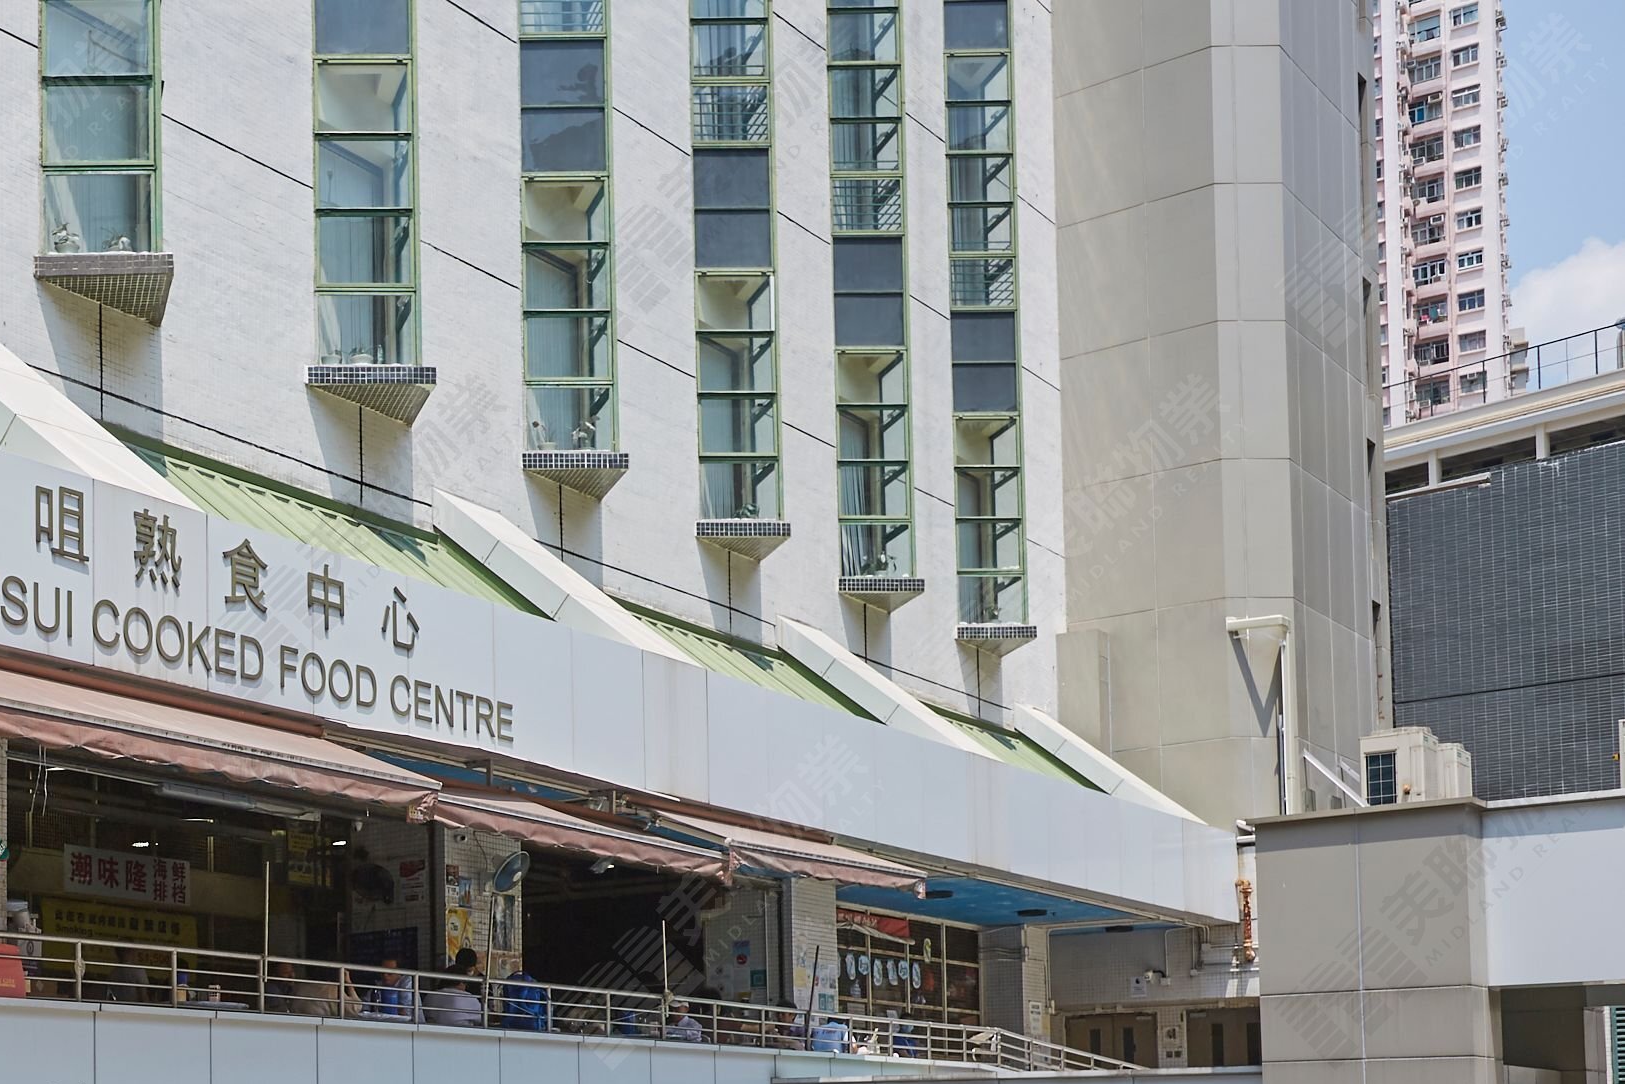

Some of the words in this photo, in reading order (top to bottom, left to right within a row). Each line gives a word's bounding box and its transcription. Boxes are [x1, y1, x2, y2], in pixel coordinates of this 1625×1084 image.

[91, 599, 264, 682] COOKED
[280, 644, 378, 708] FOOD
[390, 674, 514, 743] CENTRE
[70, 852, 147, 893] 潮味隆
